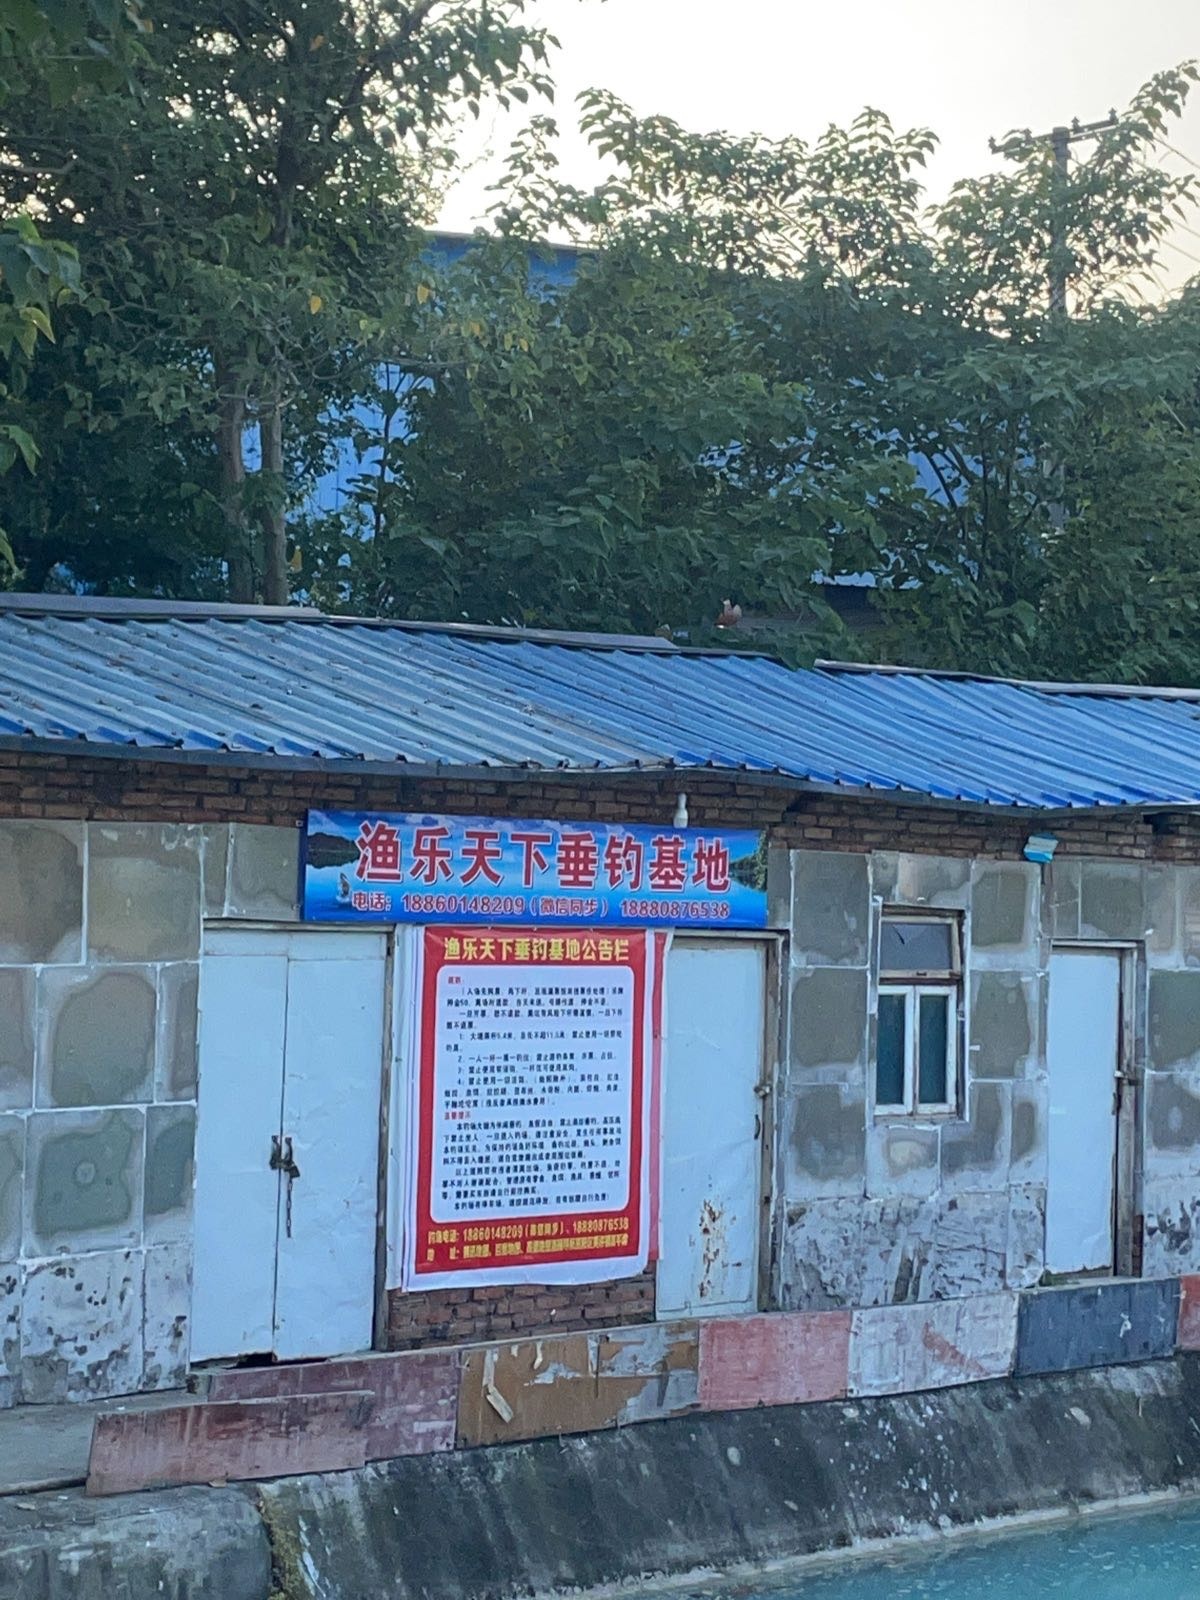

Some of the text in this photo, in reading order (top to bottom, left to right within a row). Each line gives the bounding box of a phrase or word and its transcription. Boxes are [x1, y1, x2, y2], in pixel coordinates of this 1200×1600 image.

[355, 820, 731, 894] 渔乐天下垂钓基地
[620, 900, 730, 920] 18880876538
[443, 937, 630, 961] 渔乐天下垂钓基地公告栏
